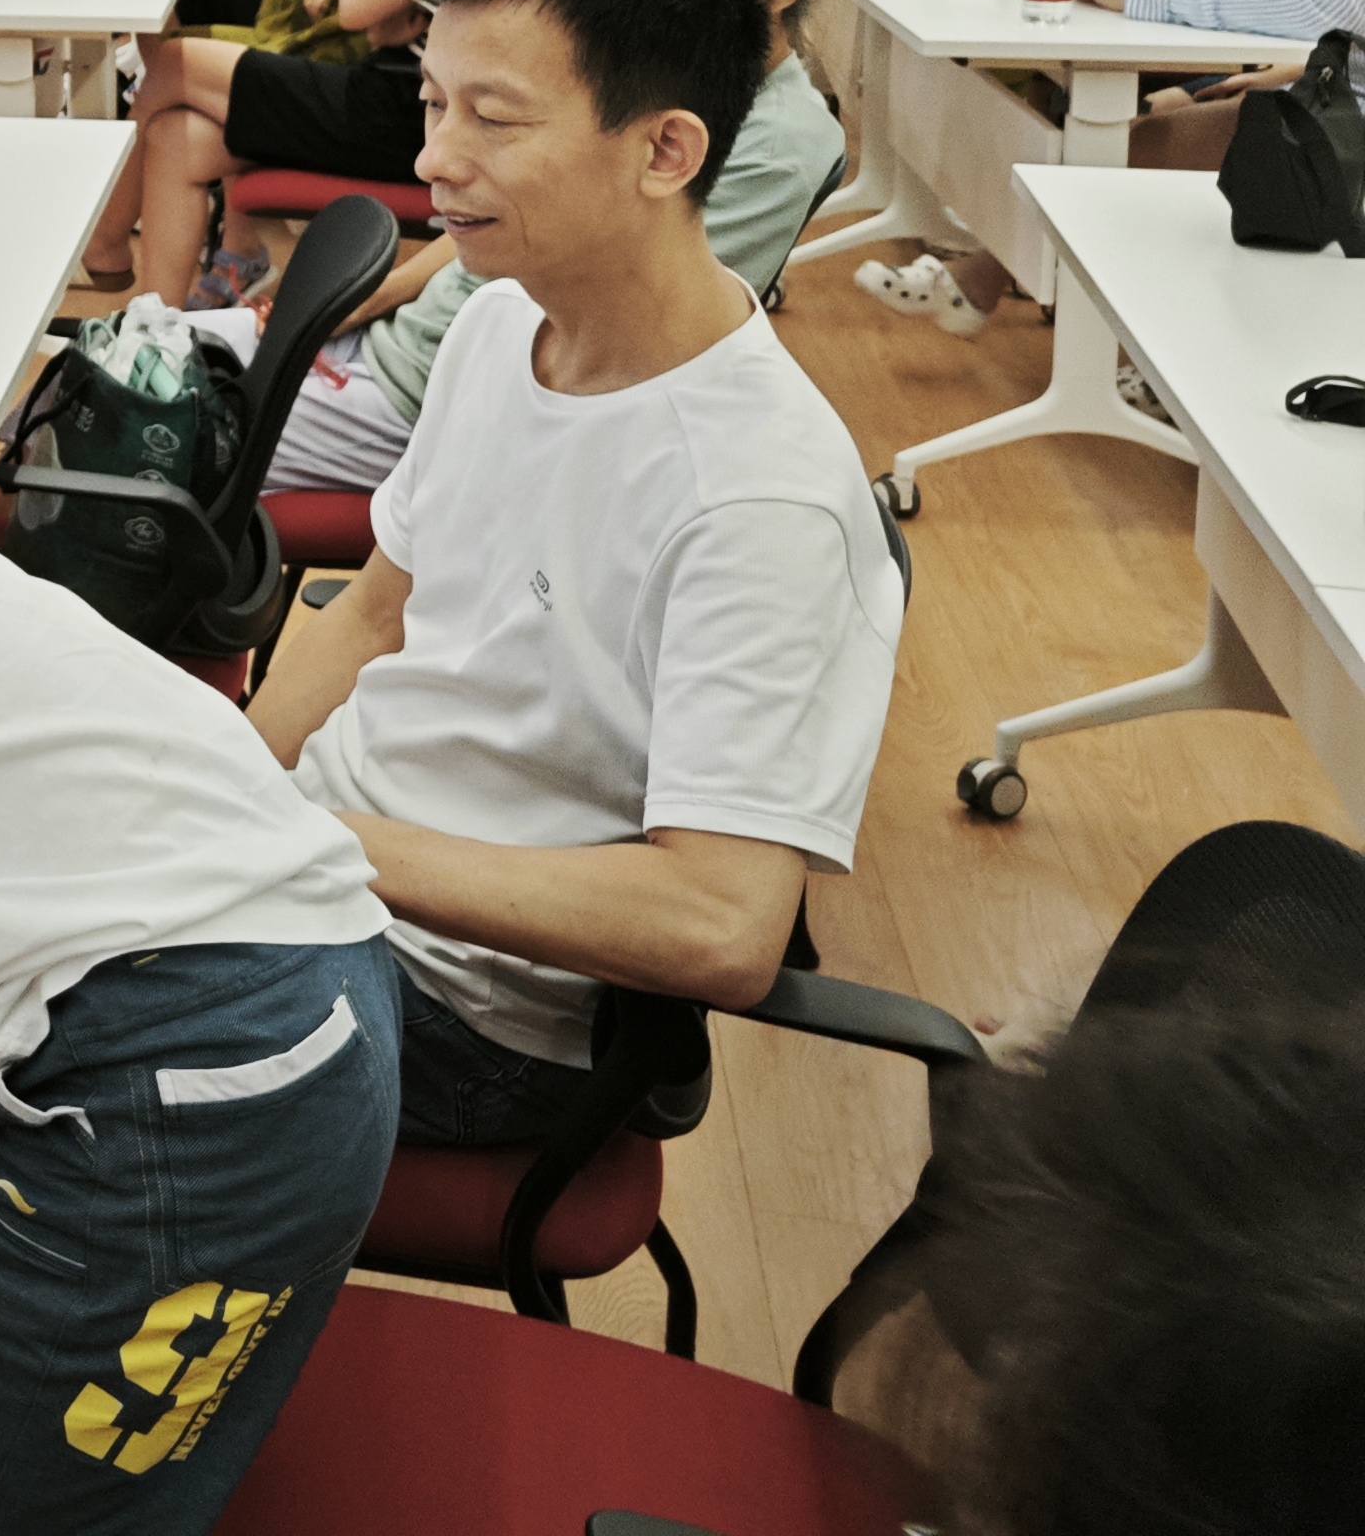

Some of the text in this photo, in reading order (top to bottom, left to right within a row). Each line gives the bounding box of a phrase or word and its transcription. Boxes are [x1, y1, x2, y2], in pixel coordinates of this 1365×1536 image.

[168, 1284, 294, 1462] NEVER GIVE UP
